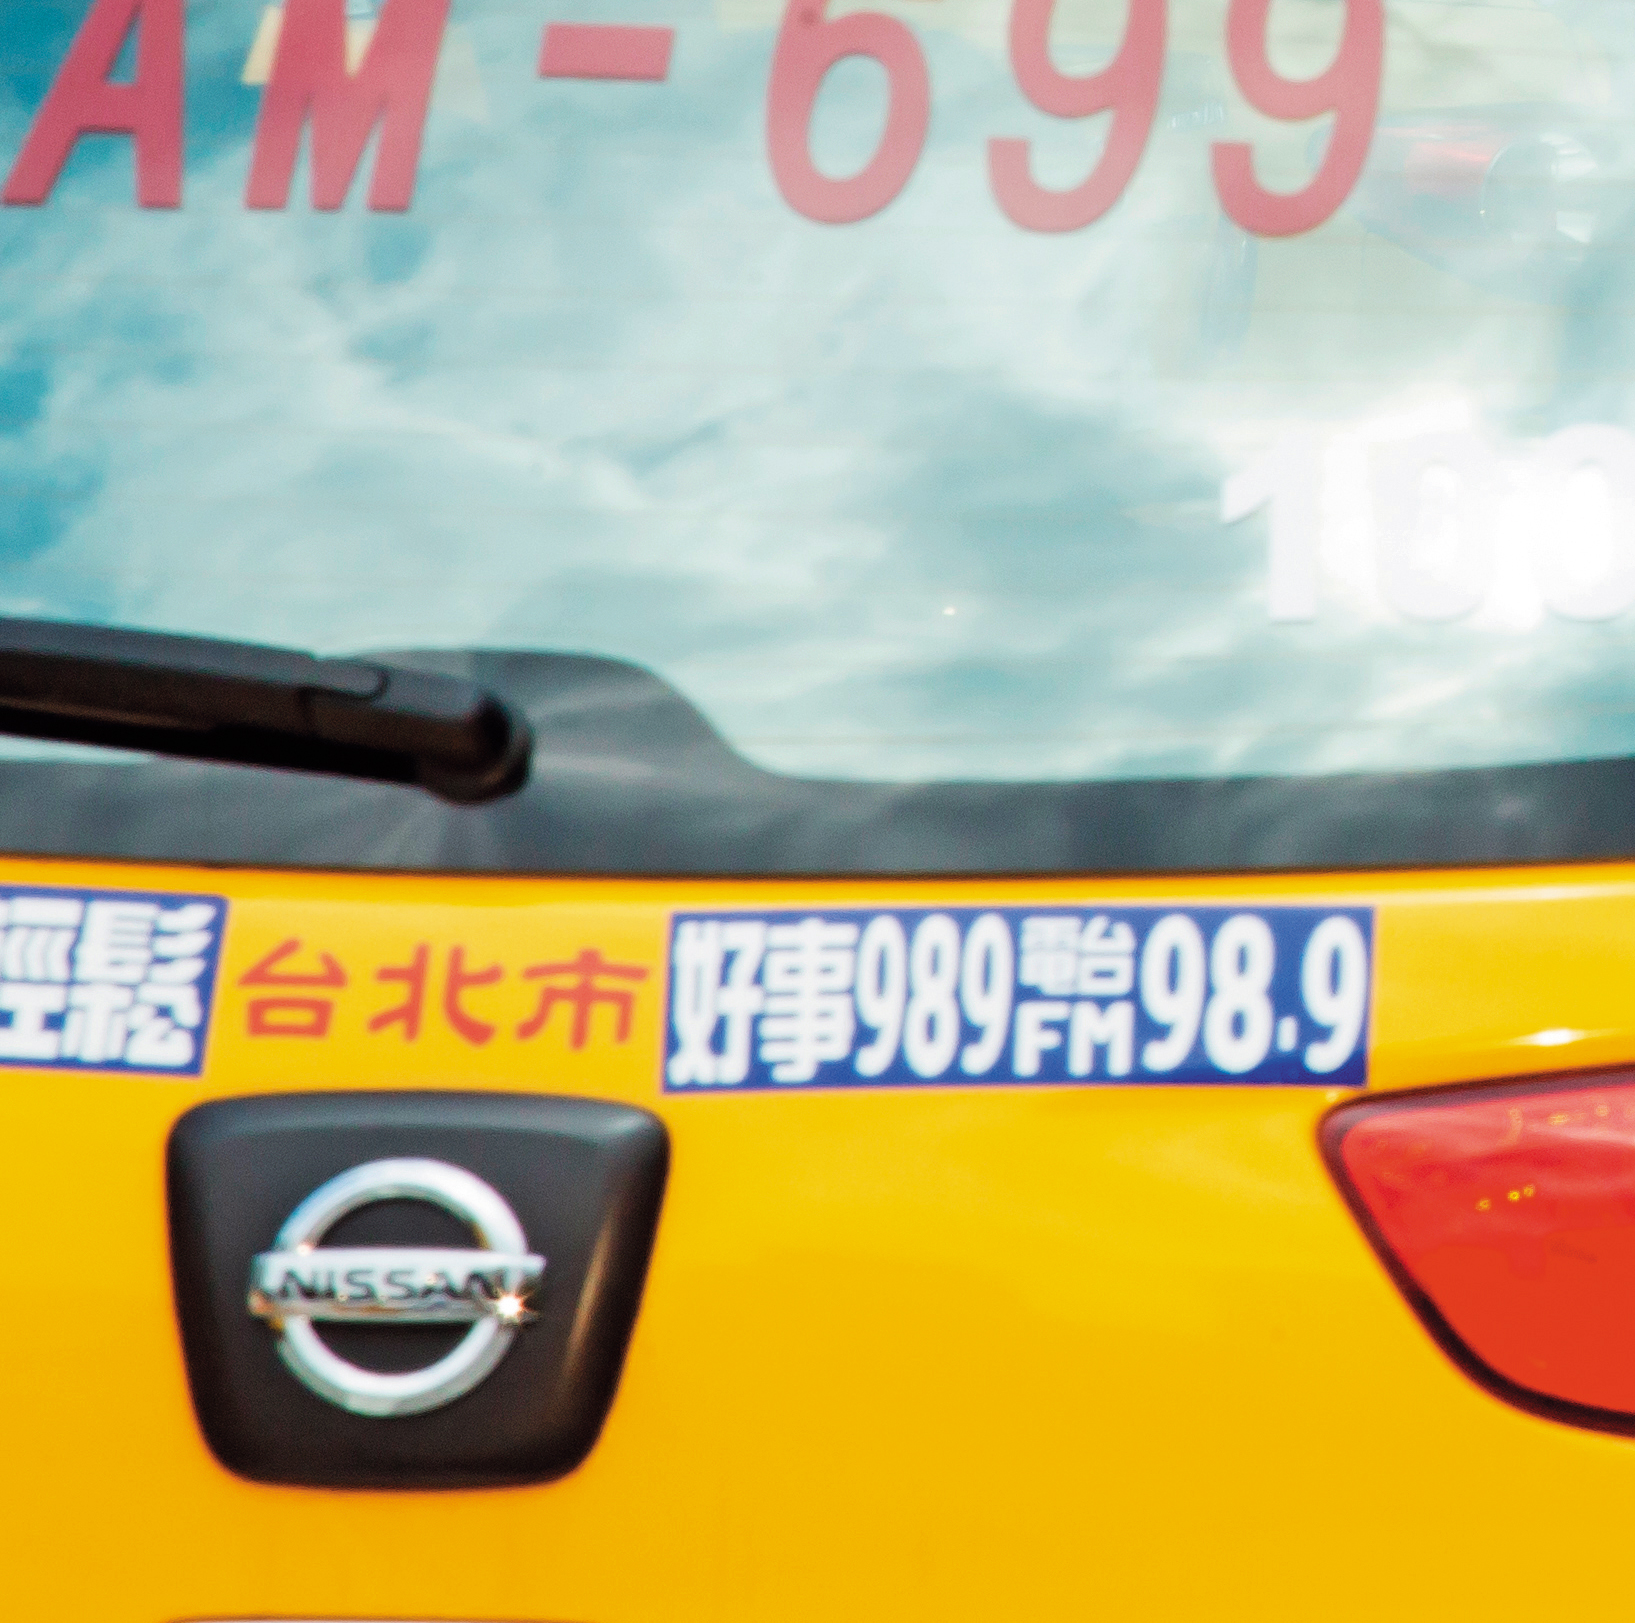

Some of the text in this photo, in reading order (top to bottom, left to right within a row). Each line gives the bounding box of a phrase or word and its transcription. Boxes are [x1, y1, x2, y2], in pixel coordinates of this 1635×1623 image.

[236, 938, 650, 1051] 台北市
[277, 1266, 508, 1302] NISSAN
